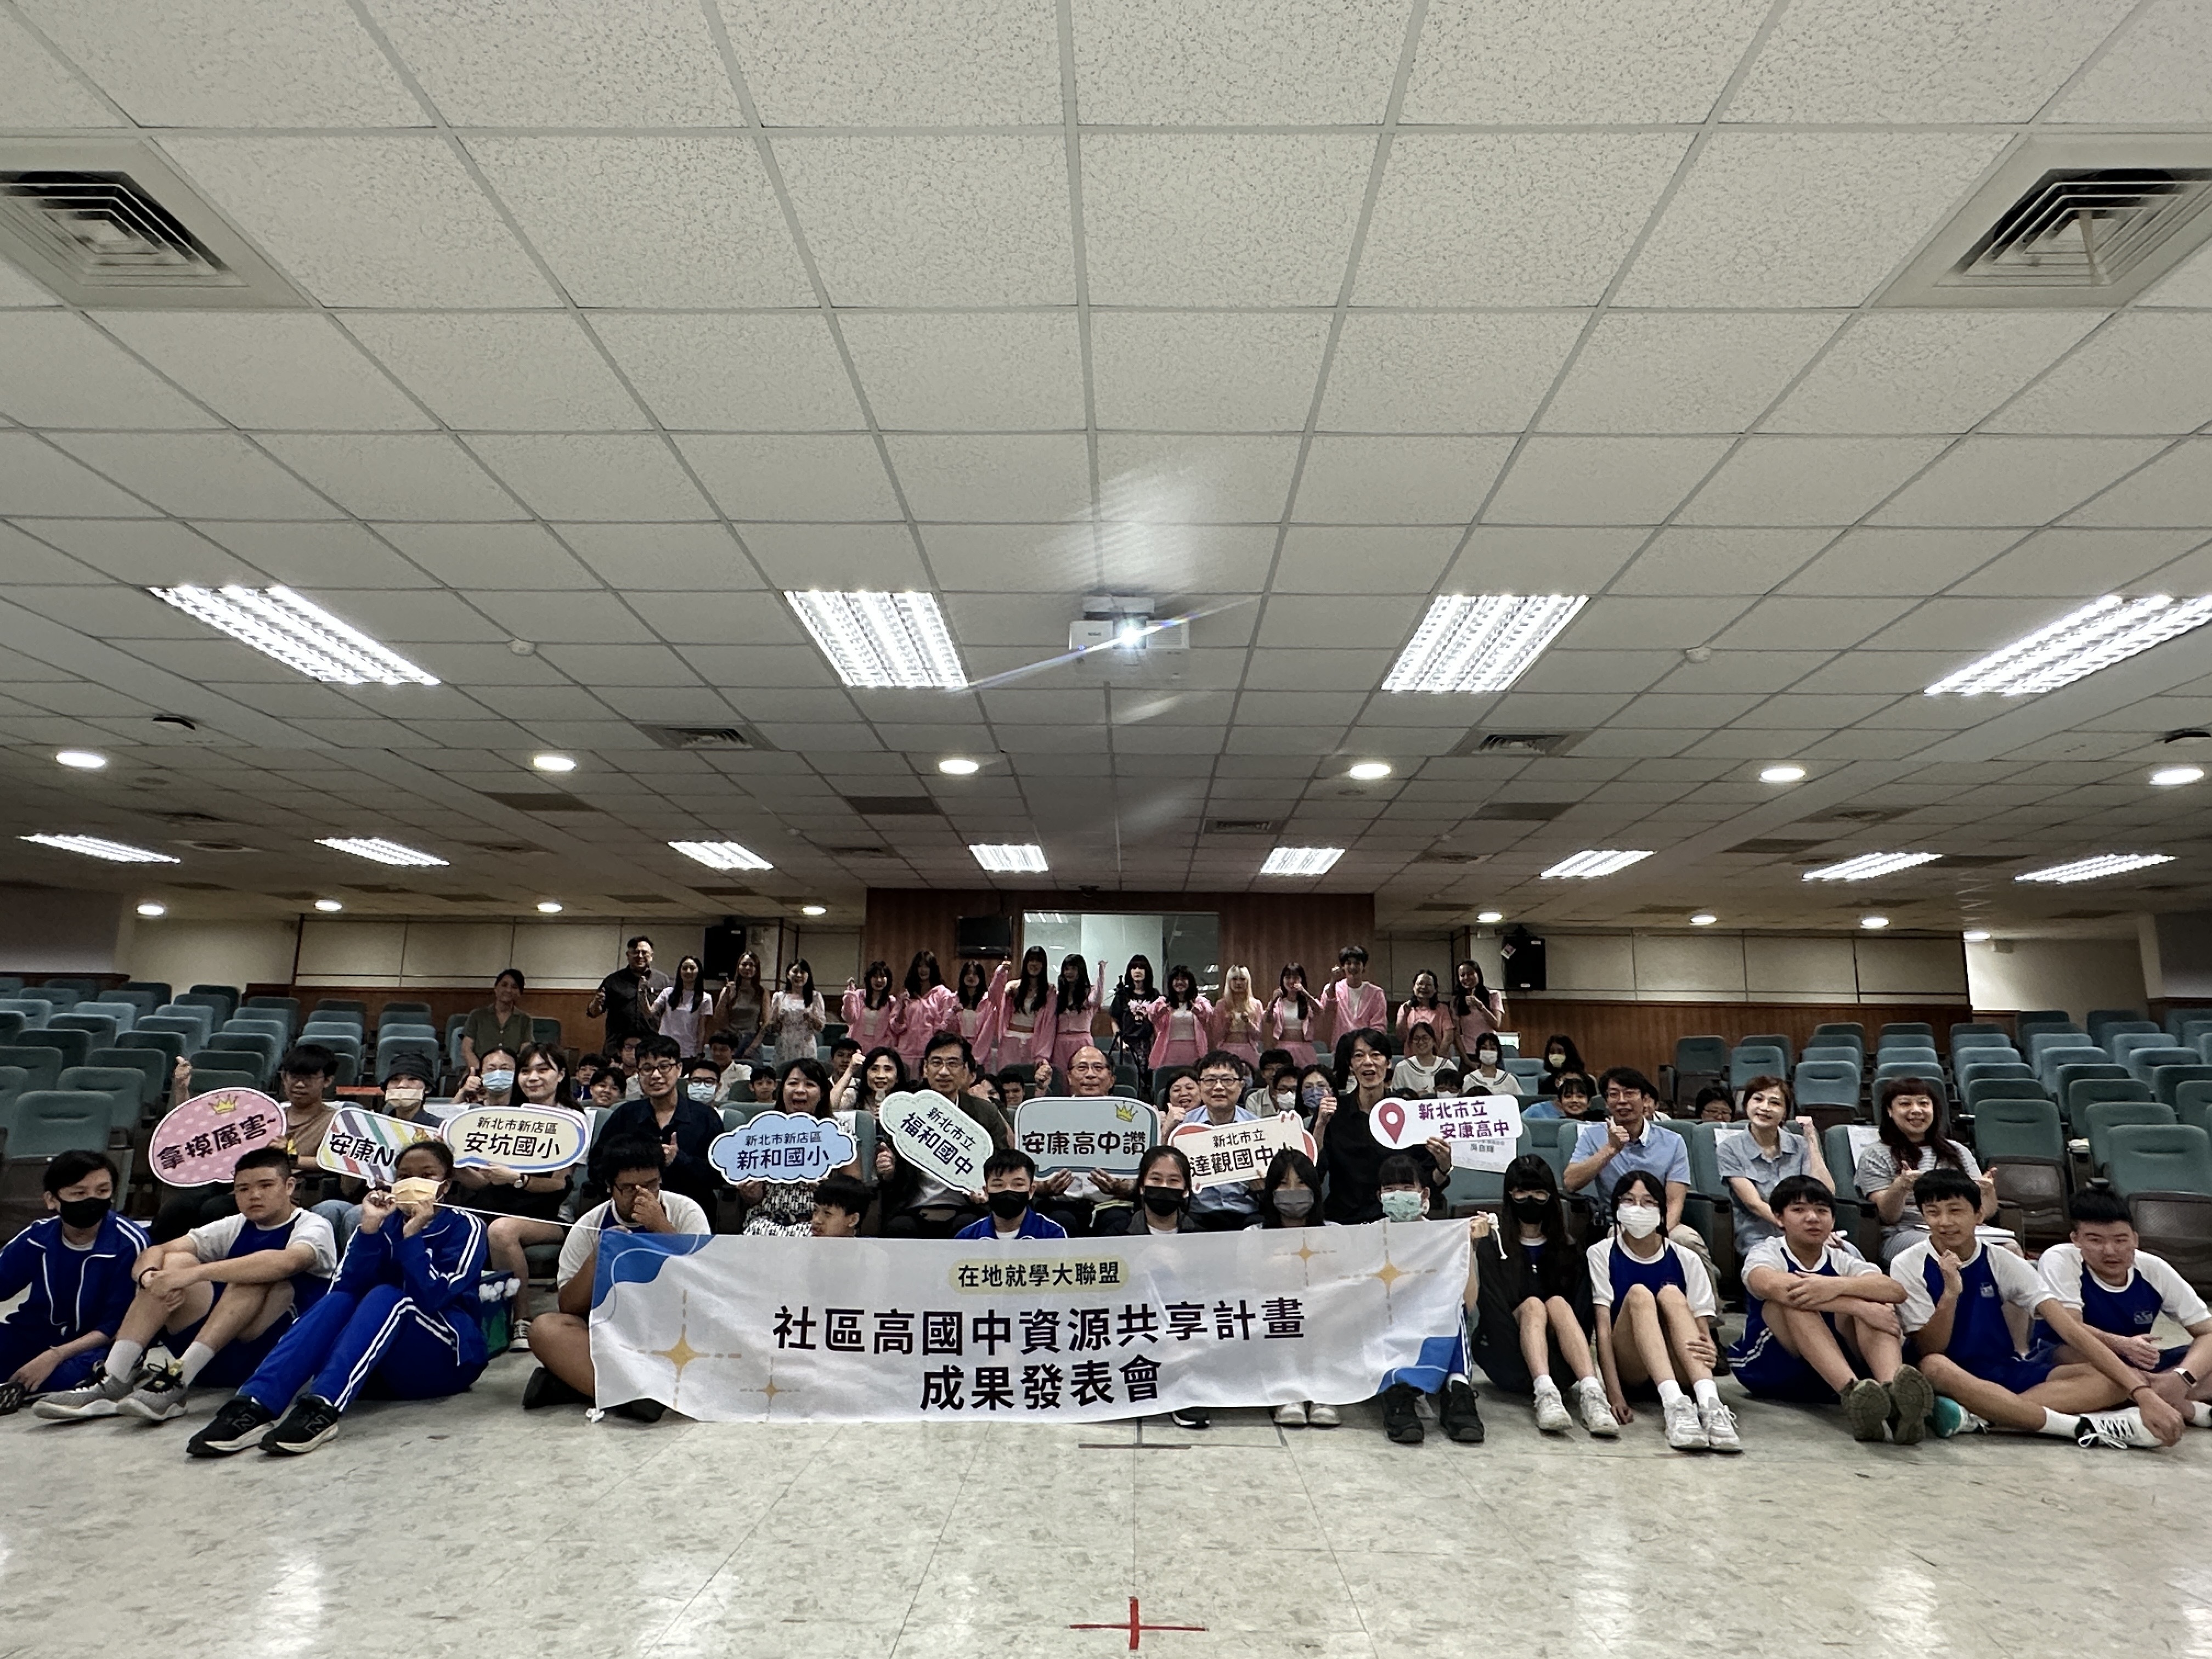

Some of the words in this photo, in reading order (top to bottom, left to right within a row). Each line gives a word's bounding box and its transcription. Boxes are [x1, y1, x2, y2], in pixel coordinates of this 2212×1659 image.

[1419, 1101, 1488, 1120] 新北市立
[476, 1117, 558, 1134] 新北市新店區
[927, 1107, 975, 1151] 新北市立
[1440, 1119, 1509, 1139] 安康高中
[464, 1132, 560, 1158] 安坑國小
[745, 1131, 822, 1147] 新北市新店區
[900, 1112, 973, 1175] 福和國中
[1022, 1131, 1146, 1155] 安康高中讚
[1213, 1128, 1266, 1148] 新北市立
[737, 1146, 829, 1170] 新和國小
[1189, 1142, 1293, 1177] 達觀國中
[958, 1262, 1120, 1287] 在地就學大聯盟
[773, 1297, 1305, 1356] 社區高國中資源共享計畫
[920, 1354, 1161, 1410] 成果發表會
